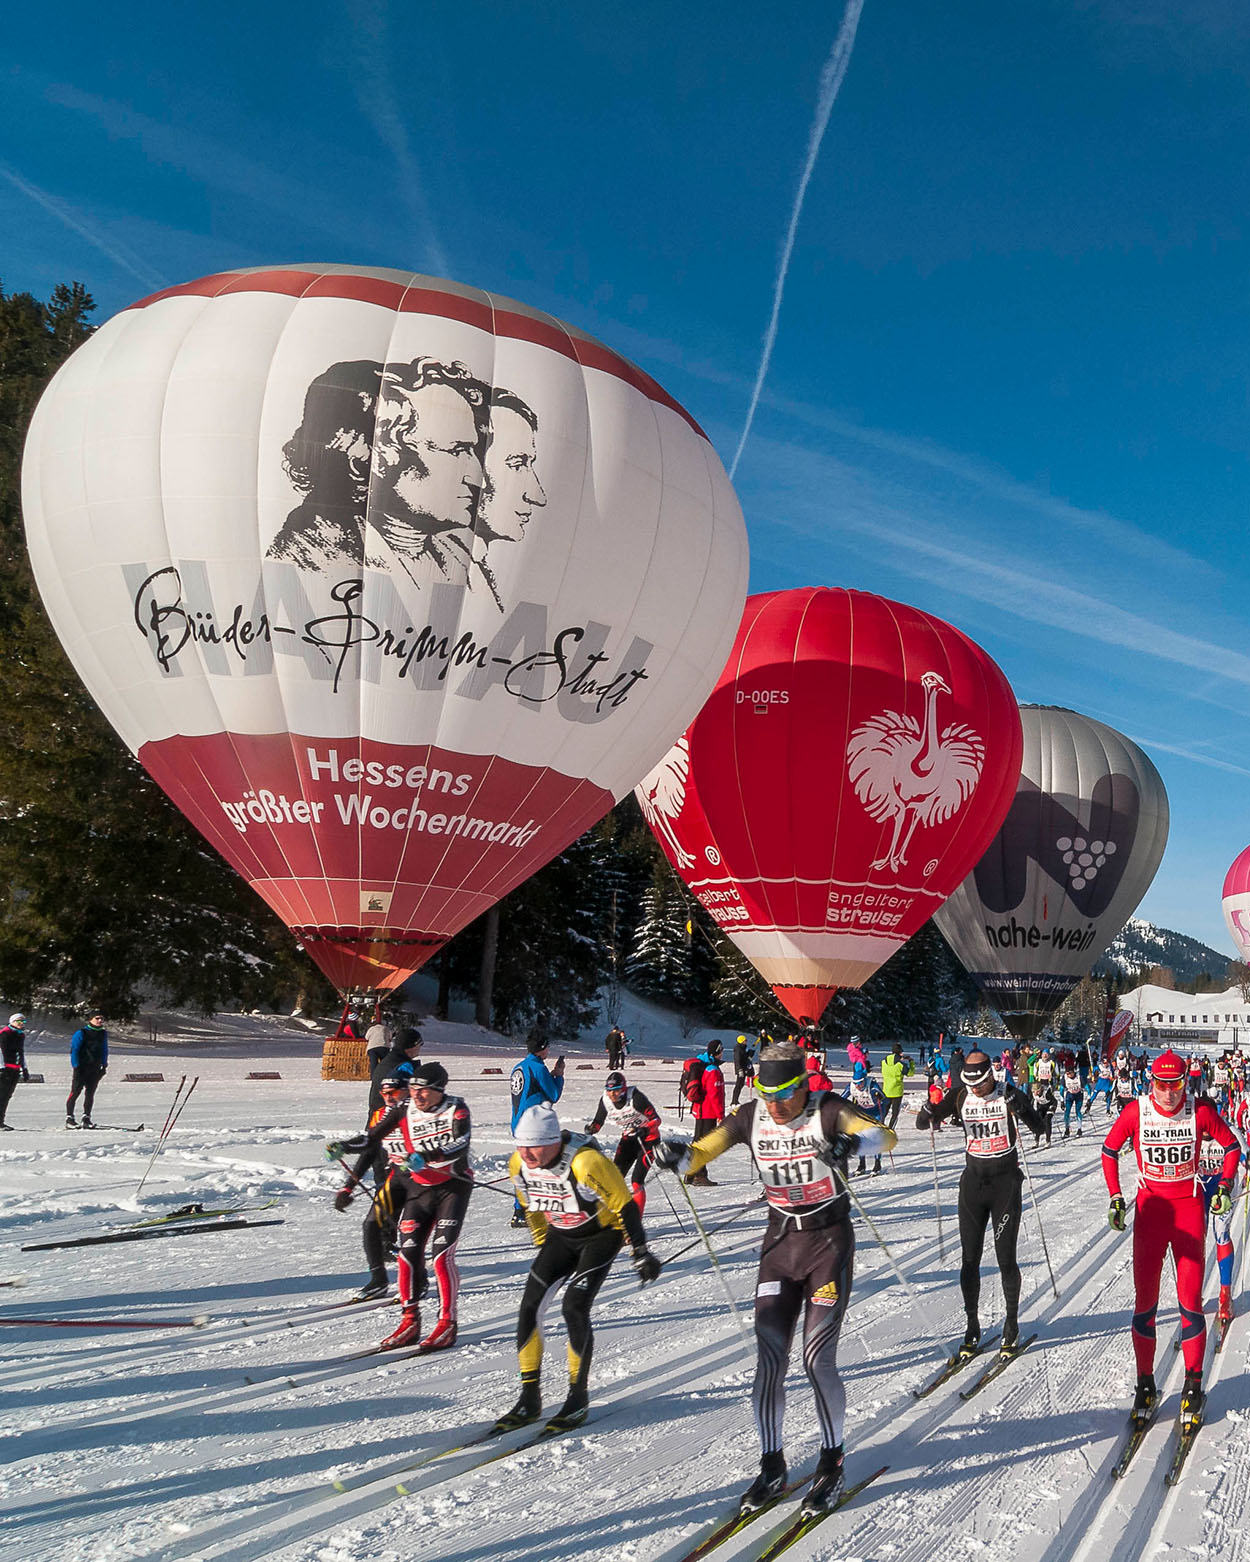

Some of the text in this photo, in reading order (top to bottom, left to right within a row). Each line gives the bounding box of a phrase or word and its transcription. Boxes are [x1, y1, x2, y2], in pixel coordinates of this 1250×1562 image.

[307, 747, 473, 796] Hessens
[222, 789, 543, 848] größter Wochenmarkt
[826, 907, 904, 926] strauss
[985, 917, 1097, 951] nahe-wein
[758, 1135, 818, 1151] SKI-TRAIL
[1144, 1128, 1193, 1138] SKI-TRAIL
[1145, 1145, 1192, 1165] 1366
[768, 1160, 813, 1185] 1117
